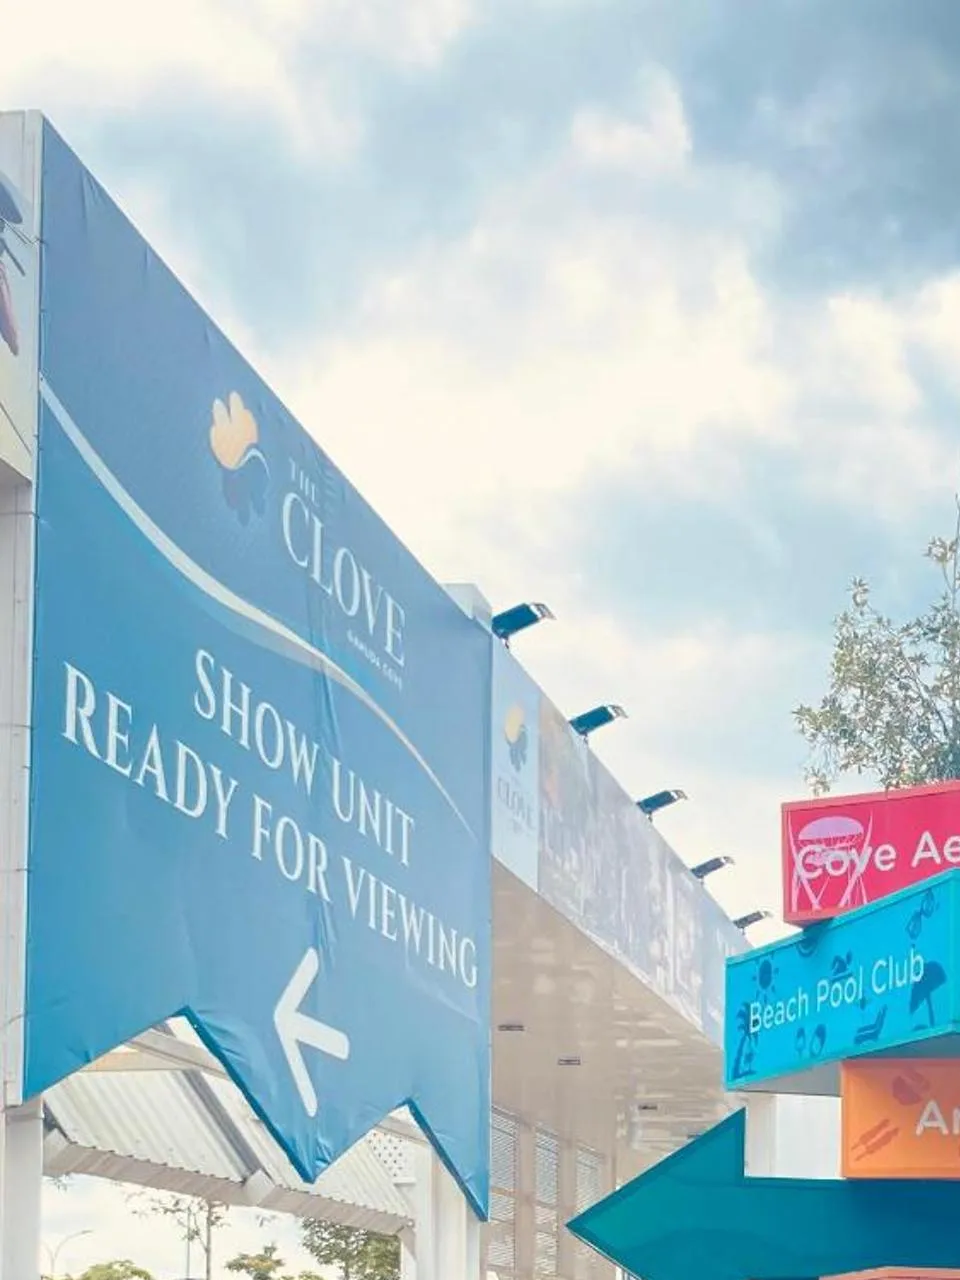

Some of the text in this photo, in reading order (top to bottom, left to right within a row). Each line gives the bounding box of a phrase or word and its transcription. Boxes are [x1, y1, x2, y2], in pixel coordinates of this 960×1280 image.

[282, 492, 406, 668] CLOVE
[61, 660, 479, 988] READY FOR VIEWING
[194, 649, 415, 867] SHOW UNIT
[799, 840, 897, 879] Cove
[749, 948, 925, 1034] Beach Pool Club
